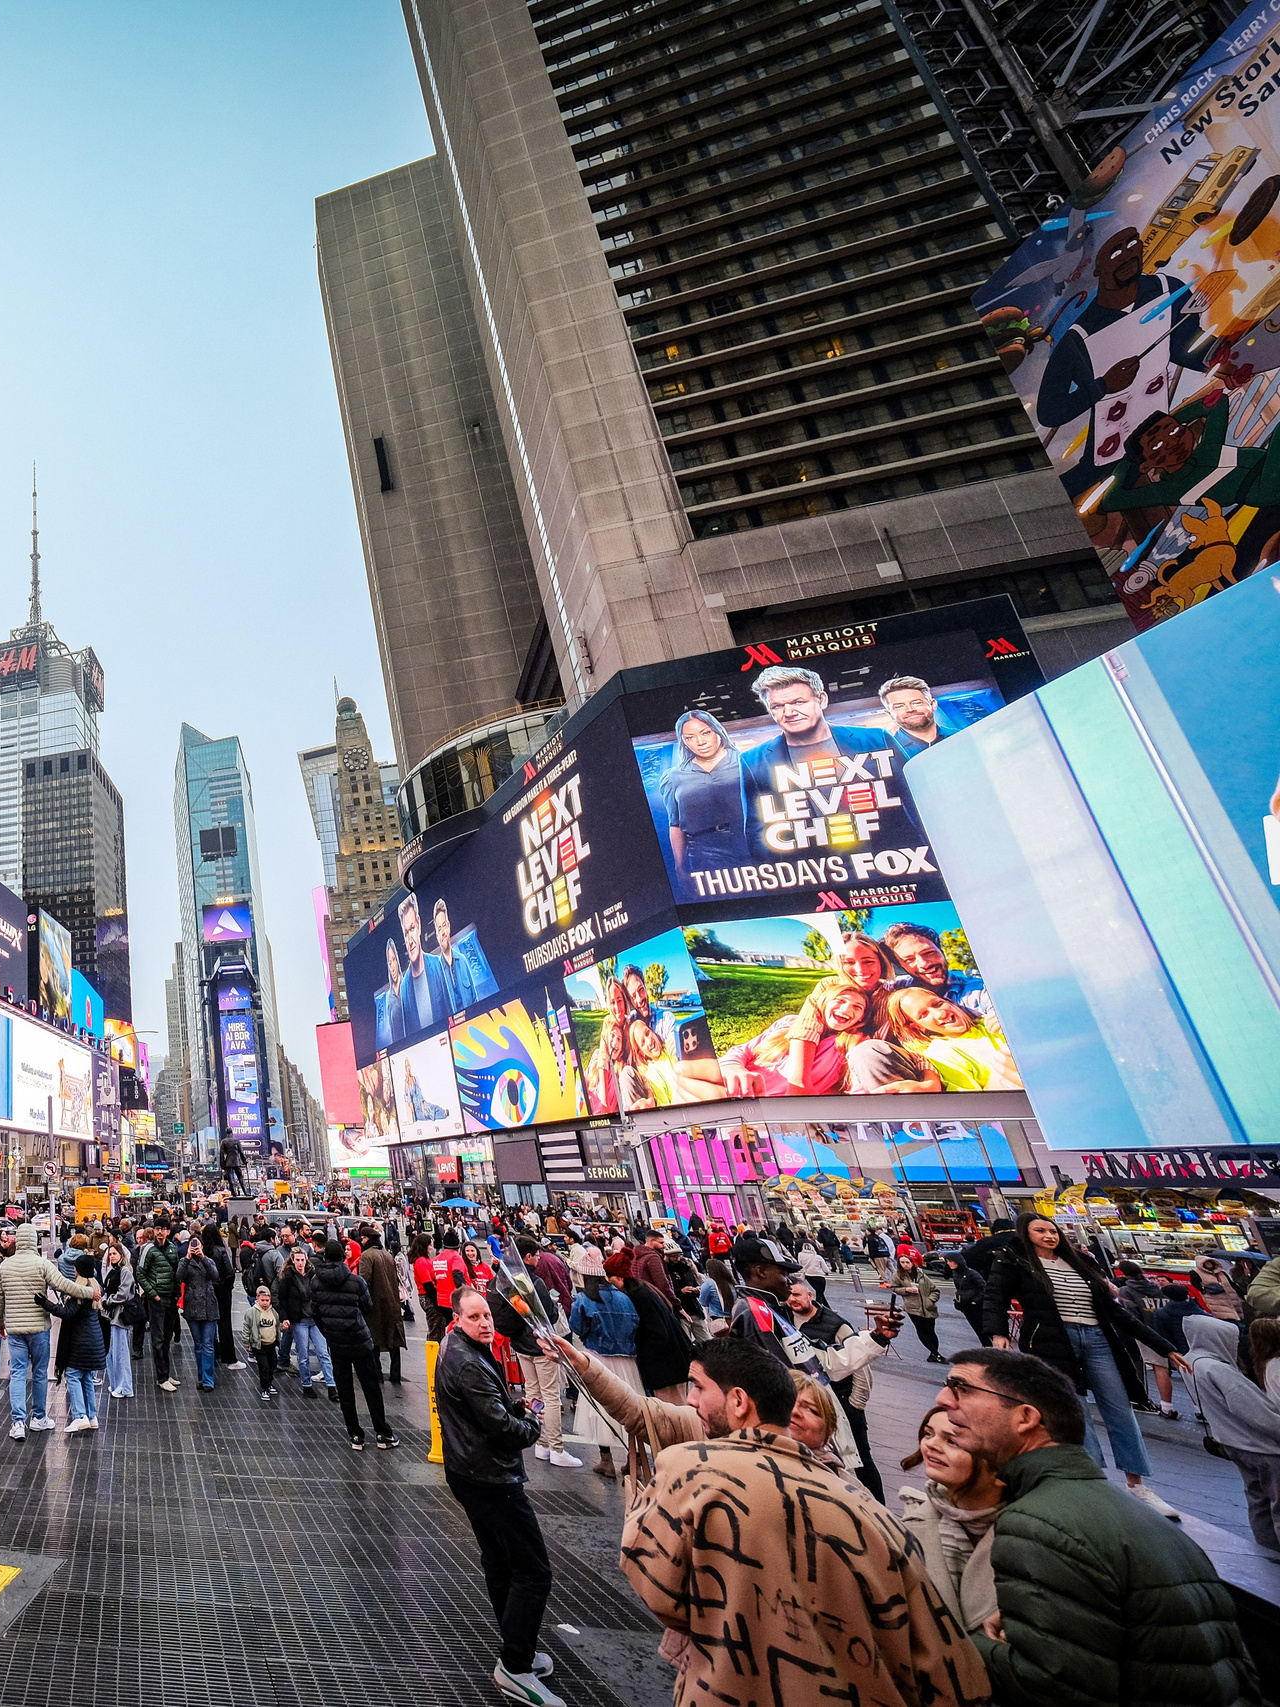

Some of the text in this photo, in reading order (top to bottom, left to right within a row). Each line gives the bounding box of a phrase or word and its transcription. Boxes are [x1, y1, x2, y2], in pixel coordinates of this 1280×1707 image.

[1144, 10, 1269, 145] CHRIS ROCK TERRY
[1159, 108, 1213, 165] New
[786, 622, 878, 648] MARRIOTT
[790, 634, 873, 659] MARQUIS
[993, 651, 1031, 661] MARRIOTT
[535, 730, 564, 762] MARRIOTT
[537, 742, 563, 771] MARQUIS
[774, 749, 895, 793] NEXT
[759, 780, 901, 824] LEVEL
[521, 773, 583, 857] NEXT
[765, 811, 879, 850] CHEF
[517, 821, 591, 900] LEVEL
[691, 845, 937, 897] THURSDAYS FOX
[524, 866, 582, 934] CHEF
[849, 883, 917, 897] MARRIOTT
[852, 892, 913, 906] MARQUIS
[603, 911, 629, 933] hulu
[522, 905, 570, 973] THURSDAYS
[567, 918, 596, 951] FOX
[572, 947, 595, 963] MARRIOTT
[227, 1022, 246, 1032] HIRE
[234, 1031, 250, 1041] BDR
[230, 1040, 247, 1050] AVA
[229, 1113, 258, 1121] MEETINGS
[237, 1106, 250, 1114] GET
[589, 1119, 611, 1128] SEPHORA
[785, 1153, 803, 1163] 5G
[587, 1166, 629, 1179] SEPHORA
